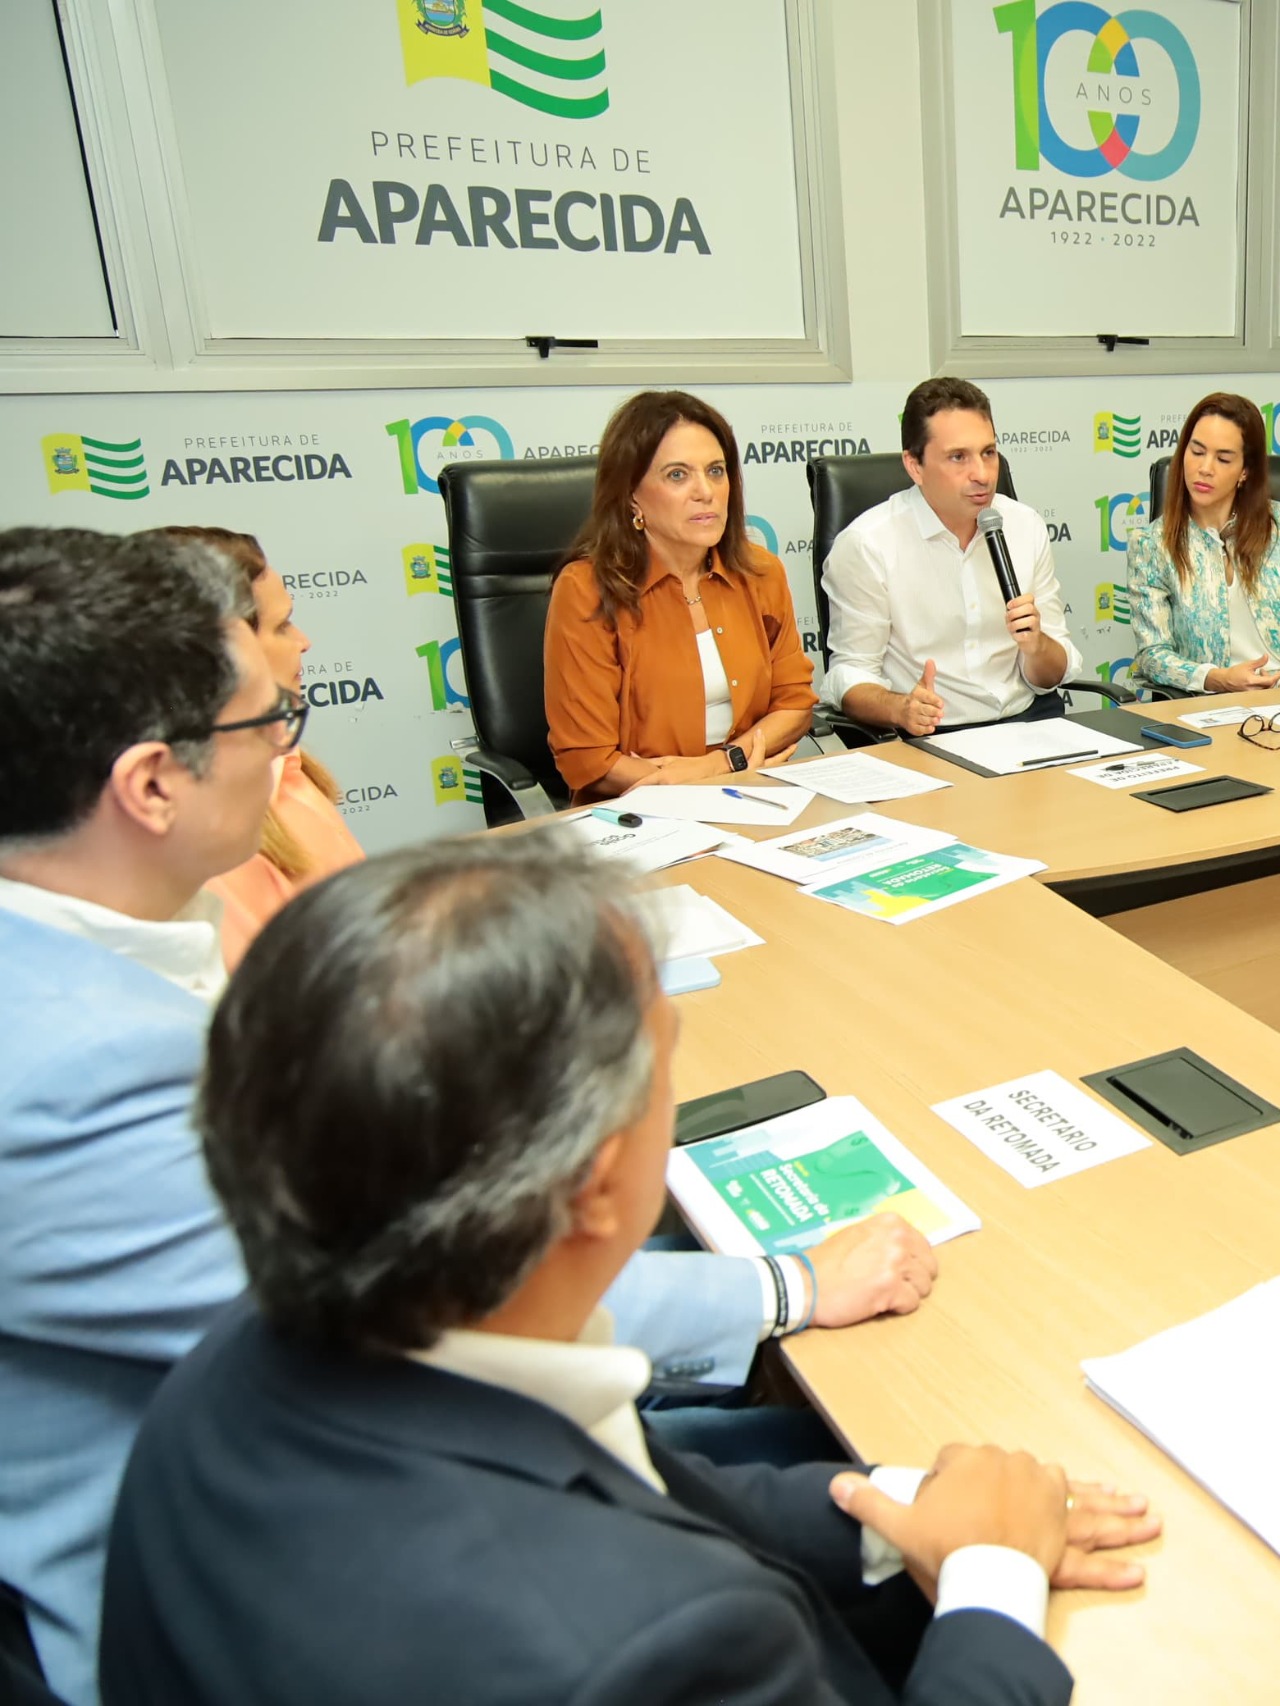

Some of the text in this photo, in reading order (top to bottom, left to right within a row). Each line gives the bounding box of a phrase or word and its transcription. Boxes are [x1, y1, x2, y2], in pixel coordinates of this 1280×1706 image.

[1076, 82, 1152, 106] ANOS
[371, 131, 651, 173] PREFEITURA DE
[999, 186, 1200, 226] APARECIDA
[317, 178, 712, 255] APARECIDA
[1051, 231, 1156, 247] 1922 2022
[761, 421, 852, 434] PREFEITURA DE
[184, 433, 320, 449] PREFEITURA DE
[437, 450, 484, 460] ANOS
[523, 443, 600, 460] APAREC
[743, 438, 871, 464] APARECIDA
[161, 453, 352, 486] APARECIDA
[1044, 509, 1056, 518] DE
[282, 569, 368, 590] RECIDA
[309, 590, 339, 599] 2022
[334, 661, 353, 673] DE
[1128, 766, 1180, 779] PREFEITO
[342, 805, 370, 815] 2022
[1008, 1089, 1098, 1152] SECRETARIO
[963, 1100, 1060, 1173] DA RETOMADA
[760, 1168, 814, 1223] RETOMADA
